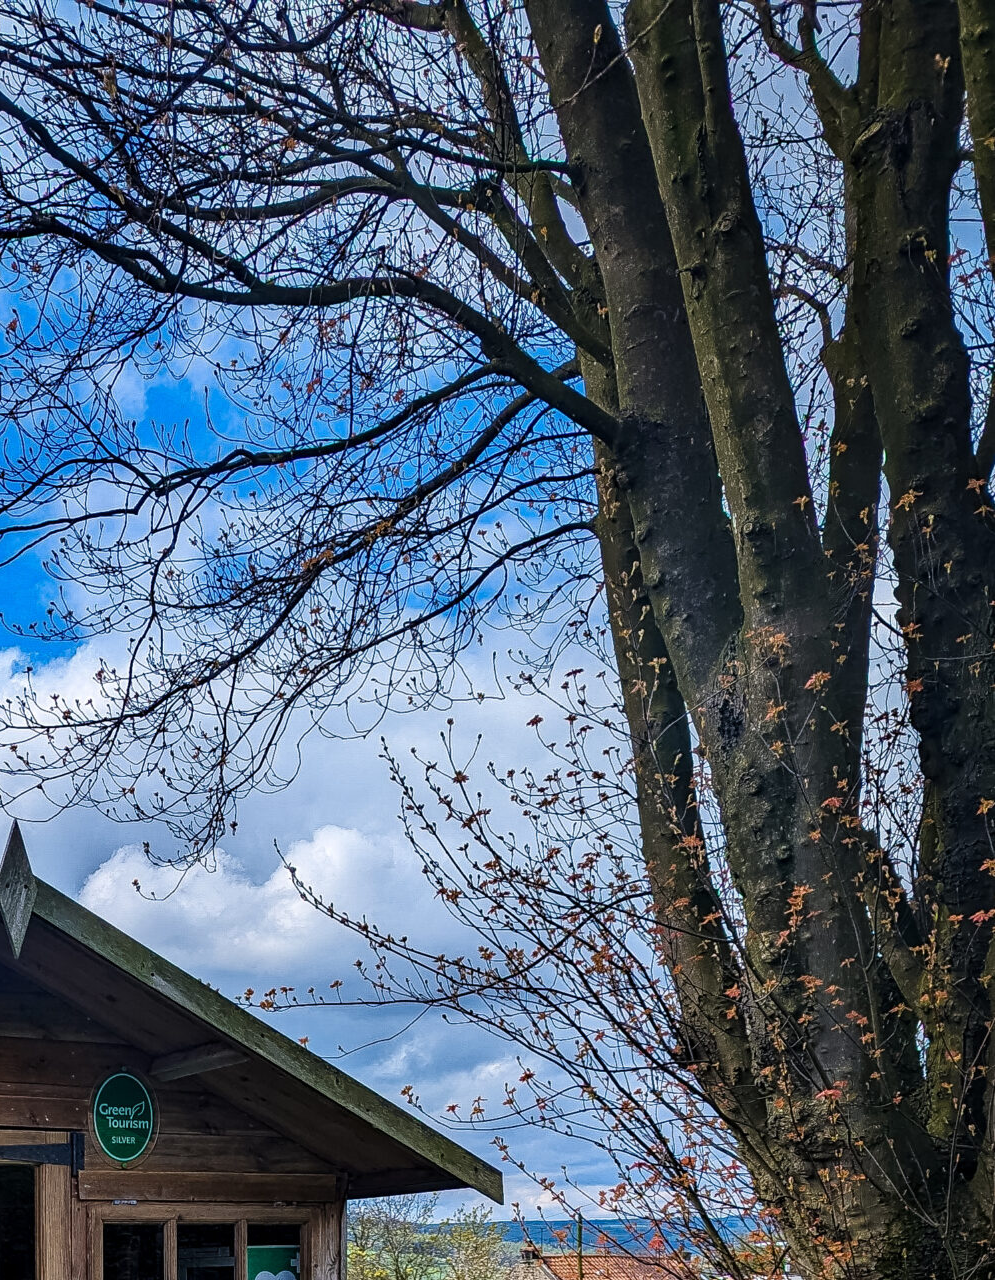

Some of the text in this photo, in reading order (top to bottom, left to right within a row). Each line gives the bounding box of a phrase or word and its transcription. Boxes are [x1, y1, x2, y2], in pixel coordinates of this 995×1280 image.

[99, 1103, 131, 1116] Green
[106, 1116, 149, 1129] Tourism
[111, 1135, 136, 1144] SILVER
